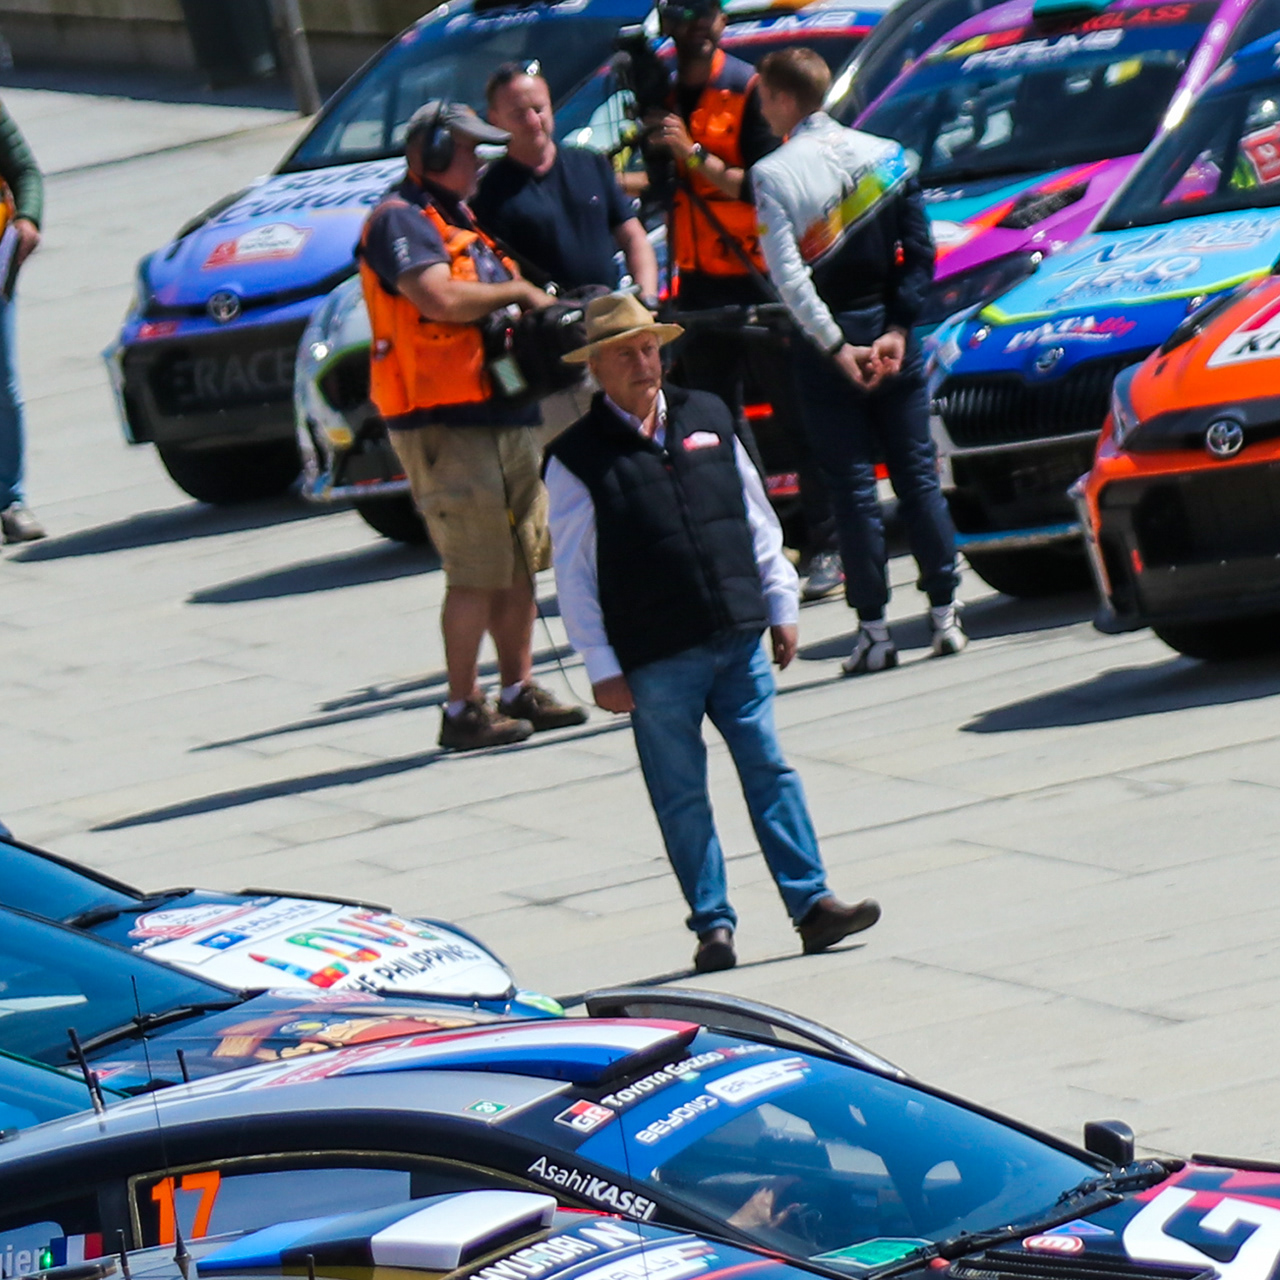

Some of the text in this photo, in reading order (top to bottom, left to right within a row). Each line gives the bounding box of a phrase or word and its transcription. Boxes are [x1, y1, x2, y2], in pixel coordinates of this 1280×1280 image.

[600, 1070, 673, 1107] TOYOTA
[151, 1171, 221, 1246] 17
[527, 1156, 657, 1221] AsahiKASEI
